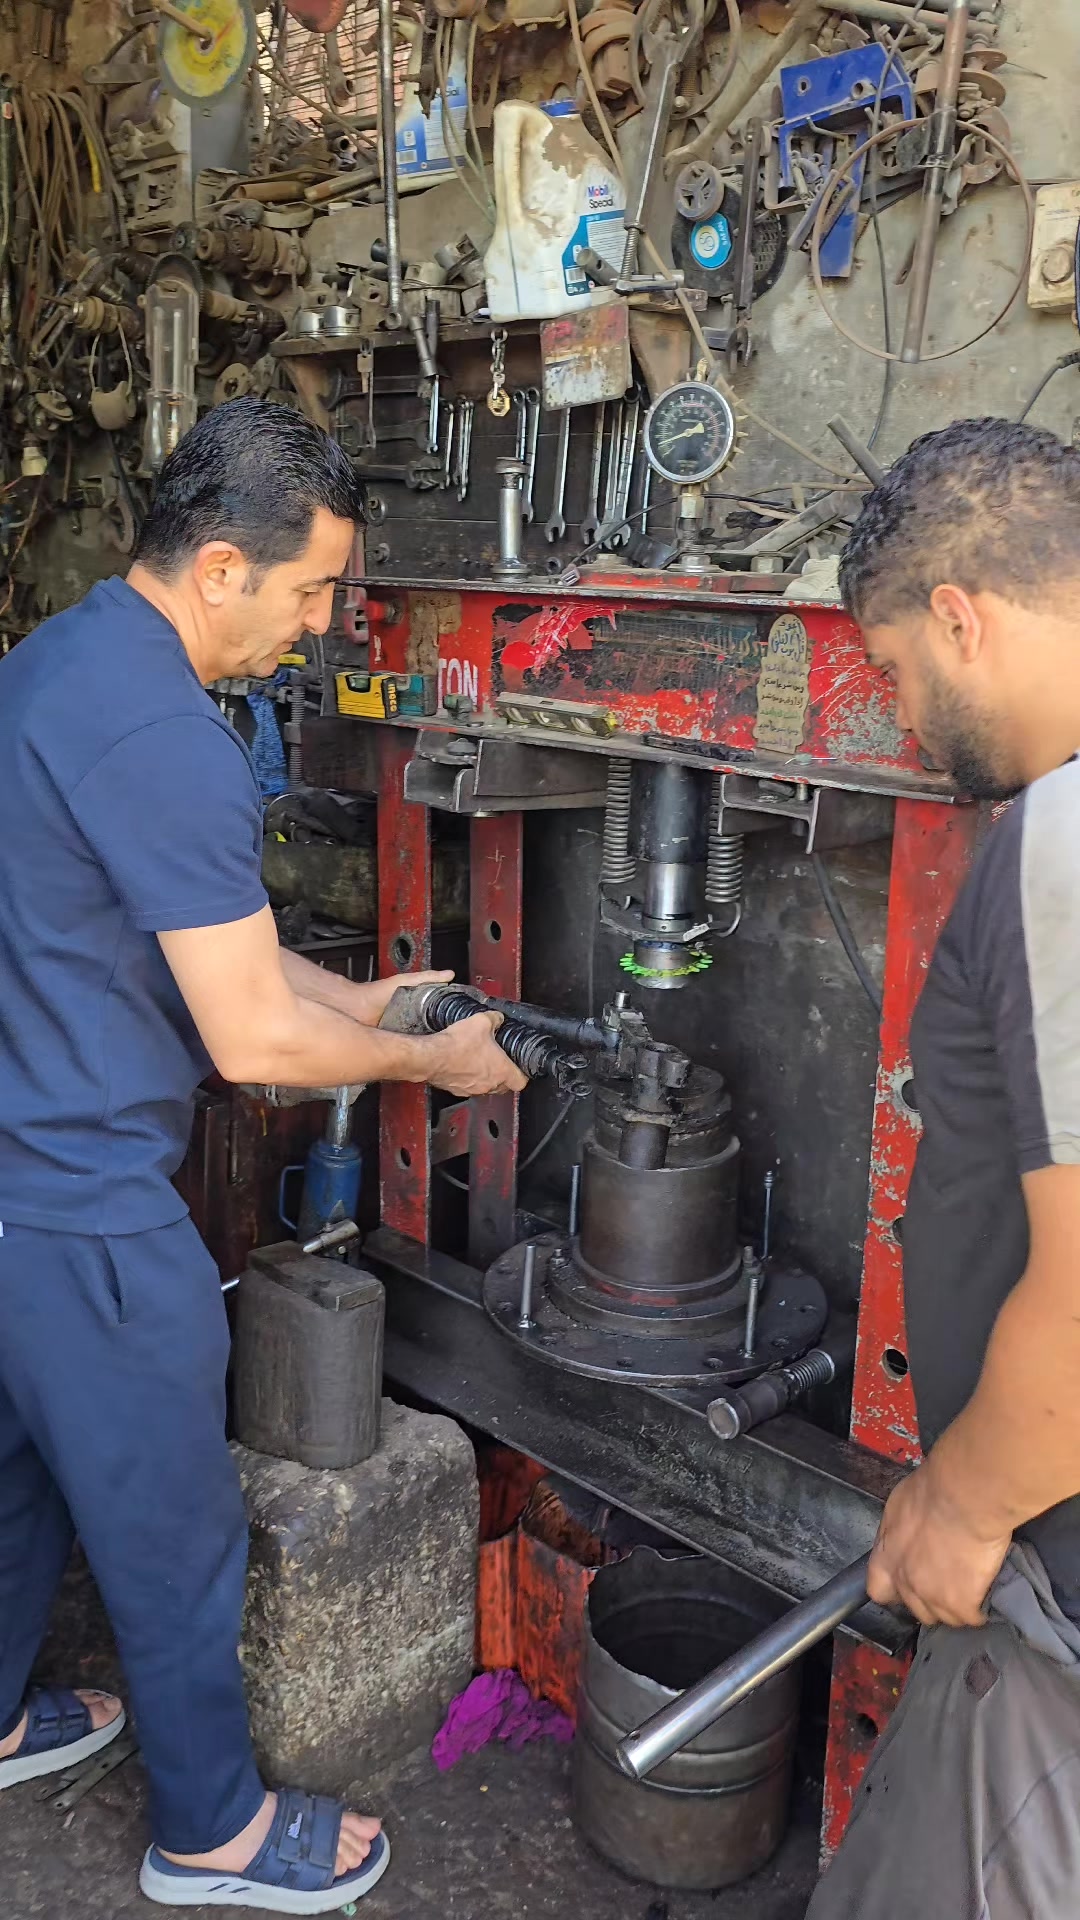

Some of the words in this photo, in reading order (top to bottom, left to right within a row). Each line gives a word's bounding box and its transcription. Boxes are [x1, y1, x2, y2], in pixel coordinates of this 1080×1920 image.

[587, 185, 609, 198] Mobil
[589, 196, 614, 209] Special
[437, 657, 479, 709] TON
